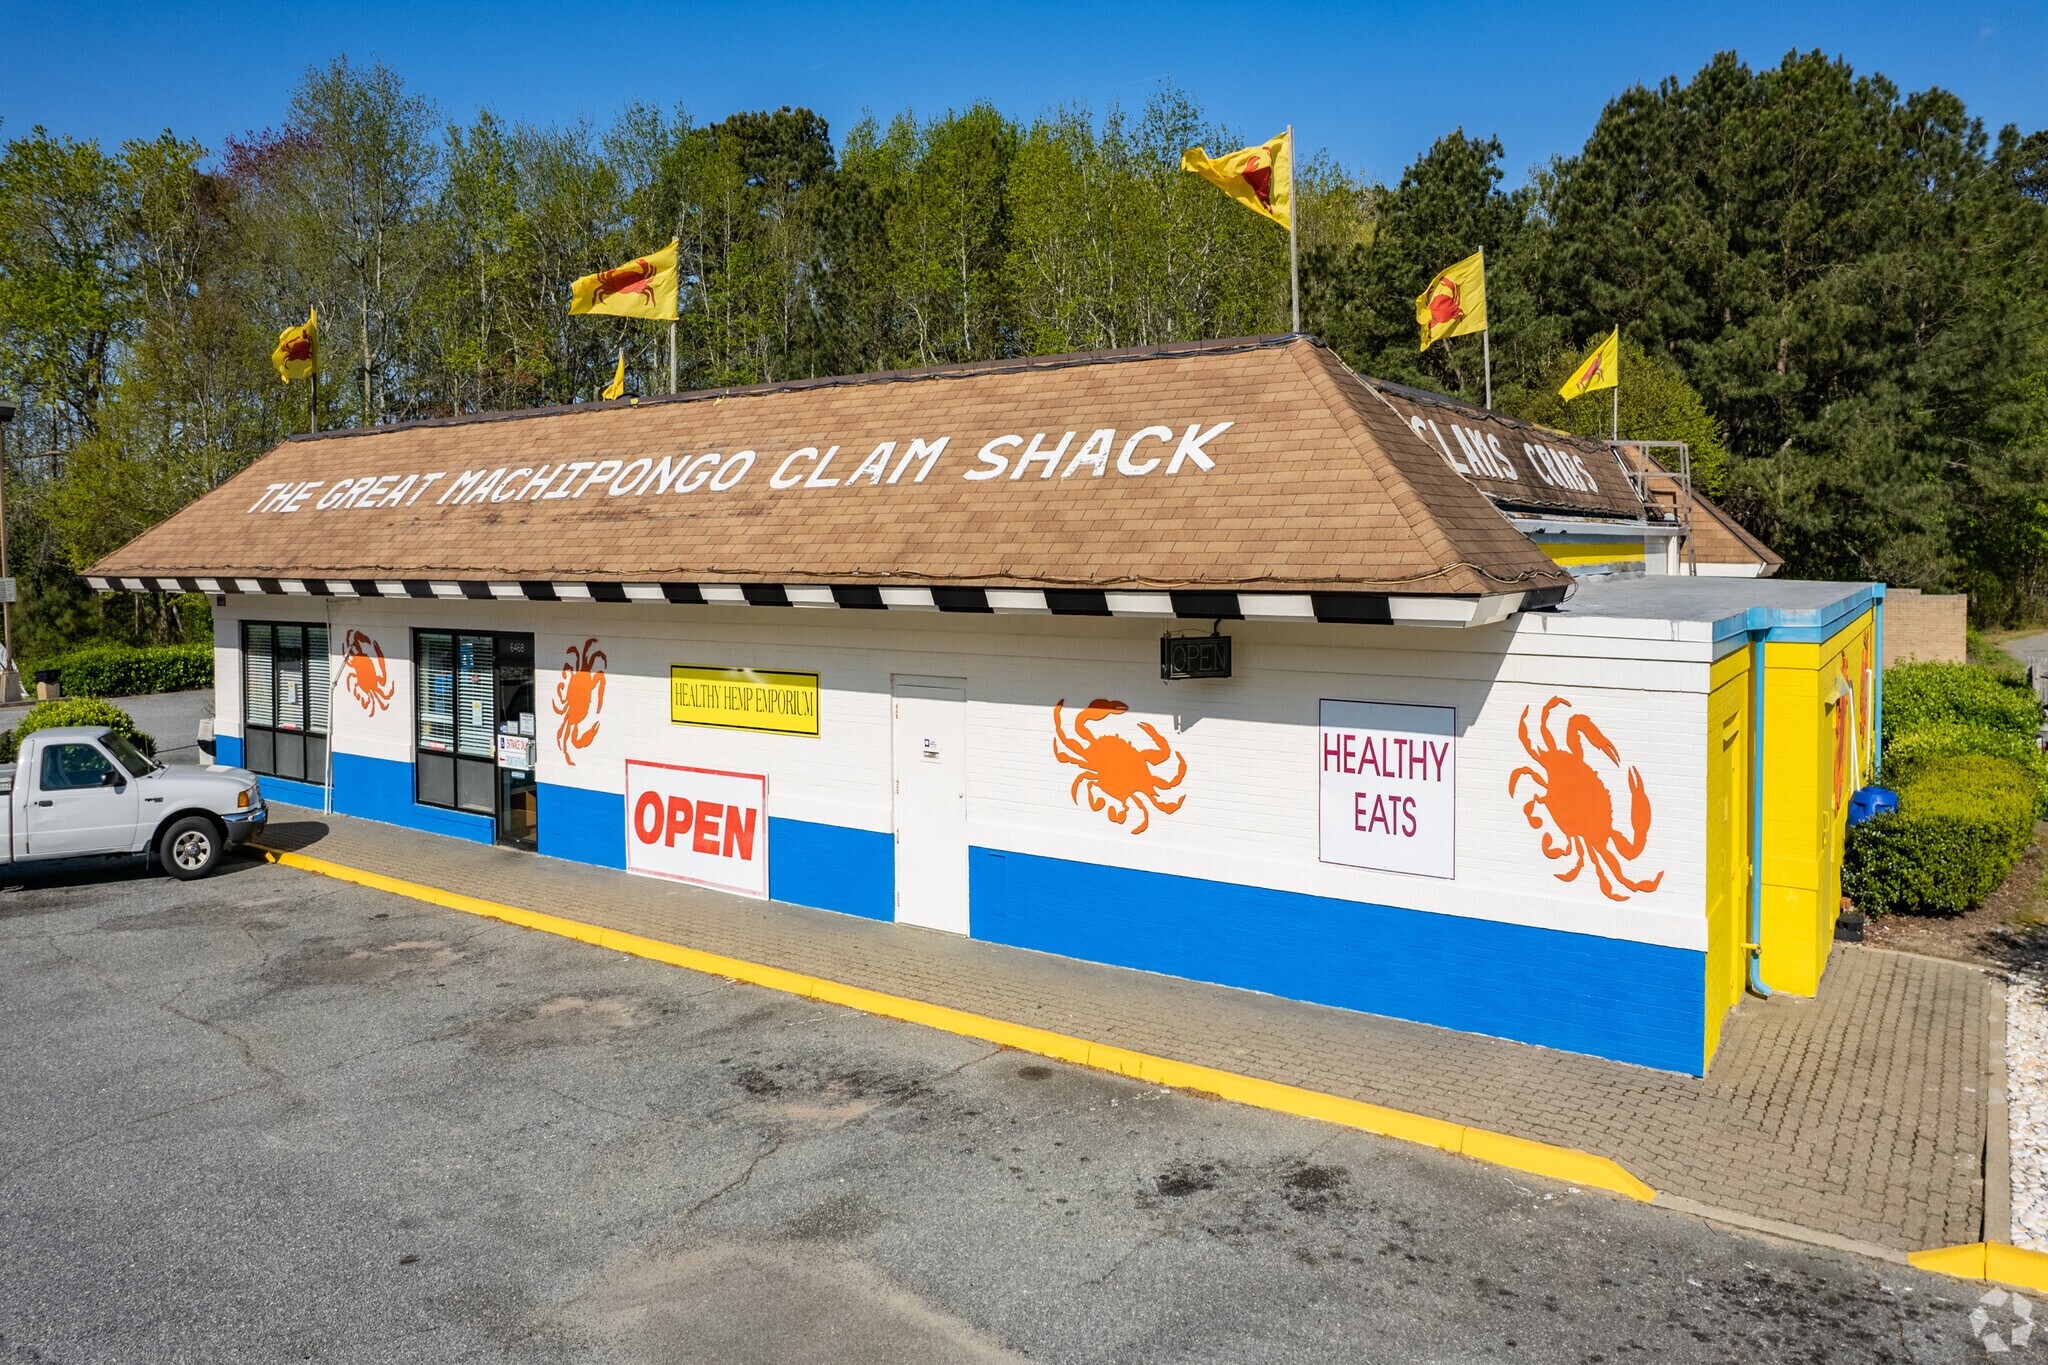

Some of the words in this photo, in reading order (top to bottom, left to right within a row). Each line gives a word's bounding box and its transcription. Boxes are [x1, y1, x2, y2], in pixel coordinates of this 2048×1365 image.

[247, 480, 325, 514] THE
[316, 472, 446, 511] GREAT
[436, 450, 757, 506] MACHIPONGO
[769, 436, 951, 489] CLAM
[962, 421, 1235, 482] SHACK
[1523, 442, 1600, 495] CRABS
[510, 642, 525, 653] 6468
[1172, 643, 1227, 673] OPEN
[675, 682, 722, 709] HEALTHY
[724, 685, 753, 712] HEMP
[756, 688, 814, 717] EMPORIUM
[1323, 732, 1450, 783] HEALTHY
[634, 790, 758, 861] OPEN
[1354, 791, 1418, 838] EATS
